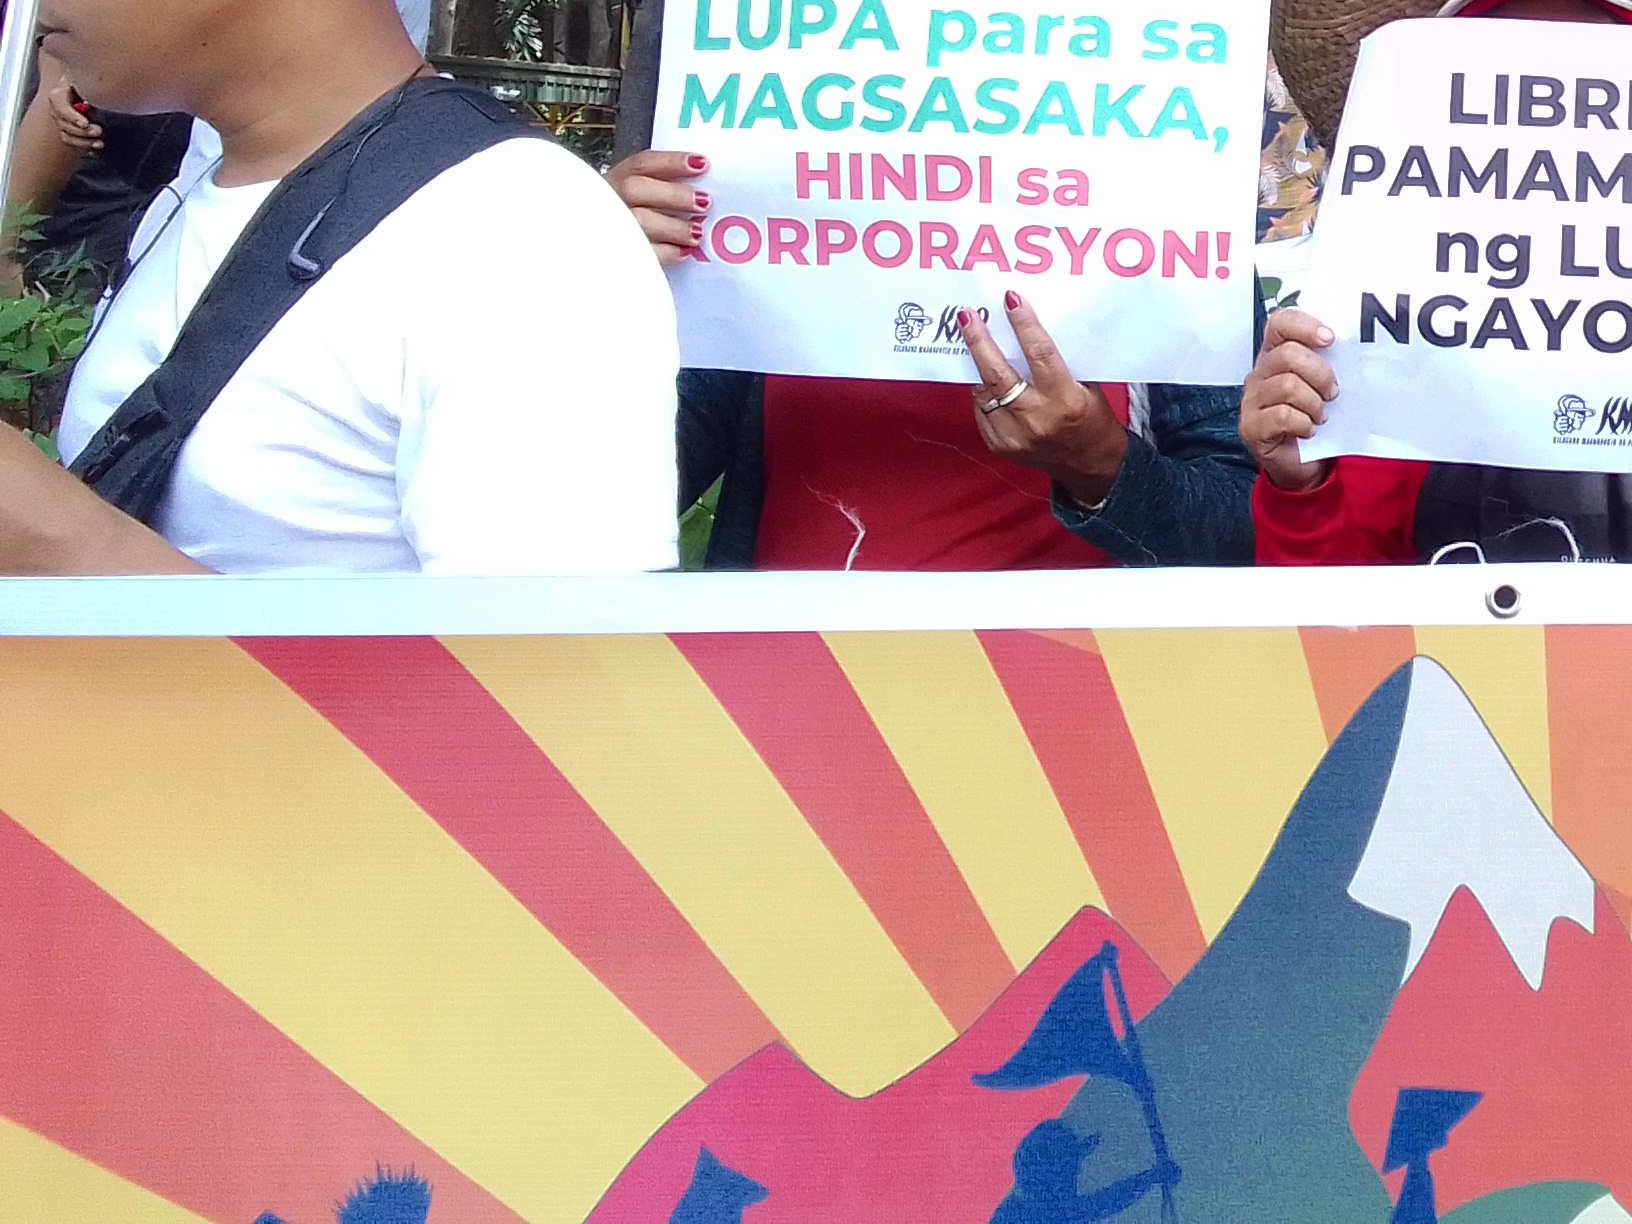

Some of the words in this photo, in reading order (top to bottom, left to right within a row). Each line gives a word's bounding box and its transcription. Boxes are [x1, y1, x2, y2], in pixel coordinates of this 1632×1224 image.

[926, 9, 1111, 67] para
[1142, 19, 1227, 64] sa
[678, 72, 1229, 152] MAGSASAKA,
[795, 151, 993, 204] HINDI
[1016, 167, 1089, 207] sa
[688, 214, 1231, 280] ORPORASYON!
[1436, 229, 1530, 289] ng
